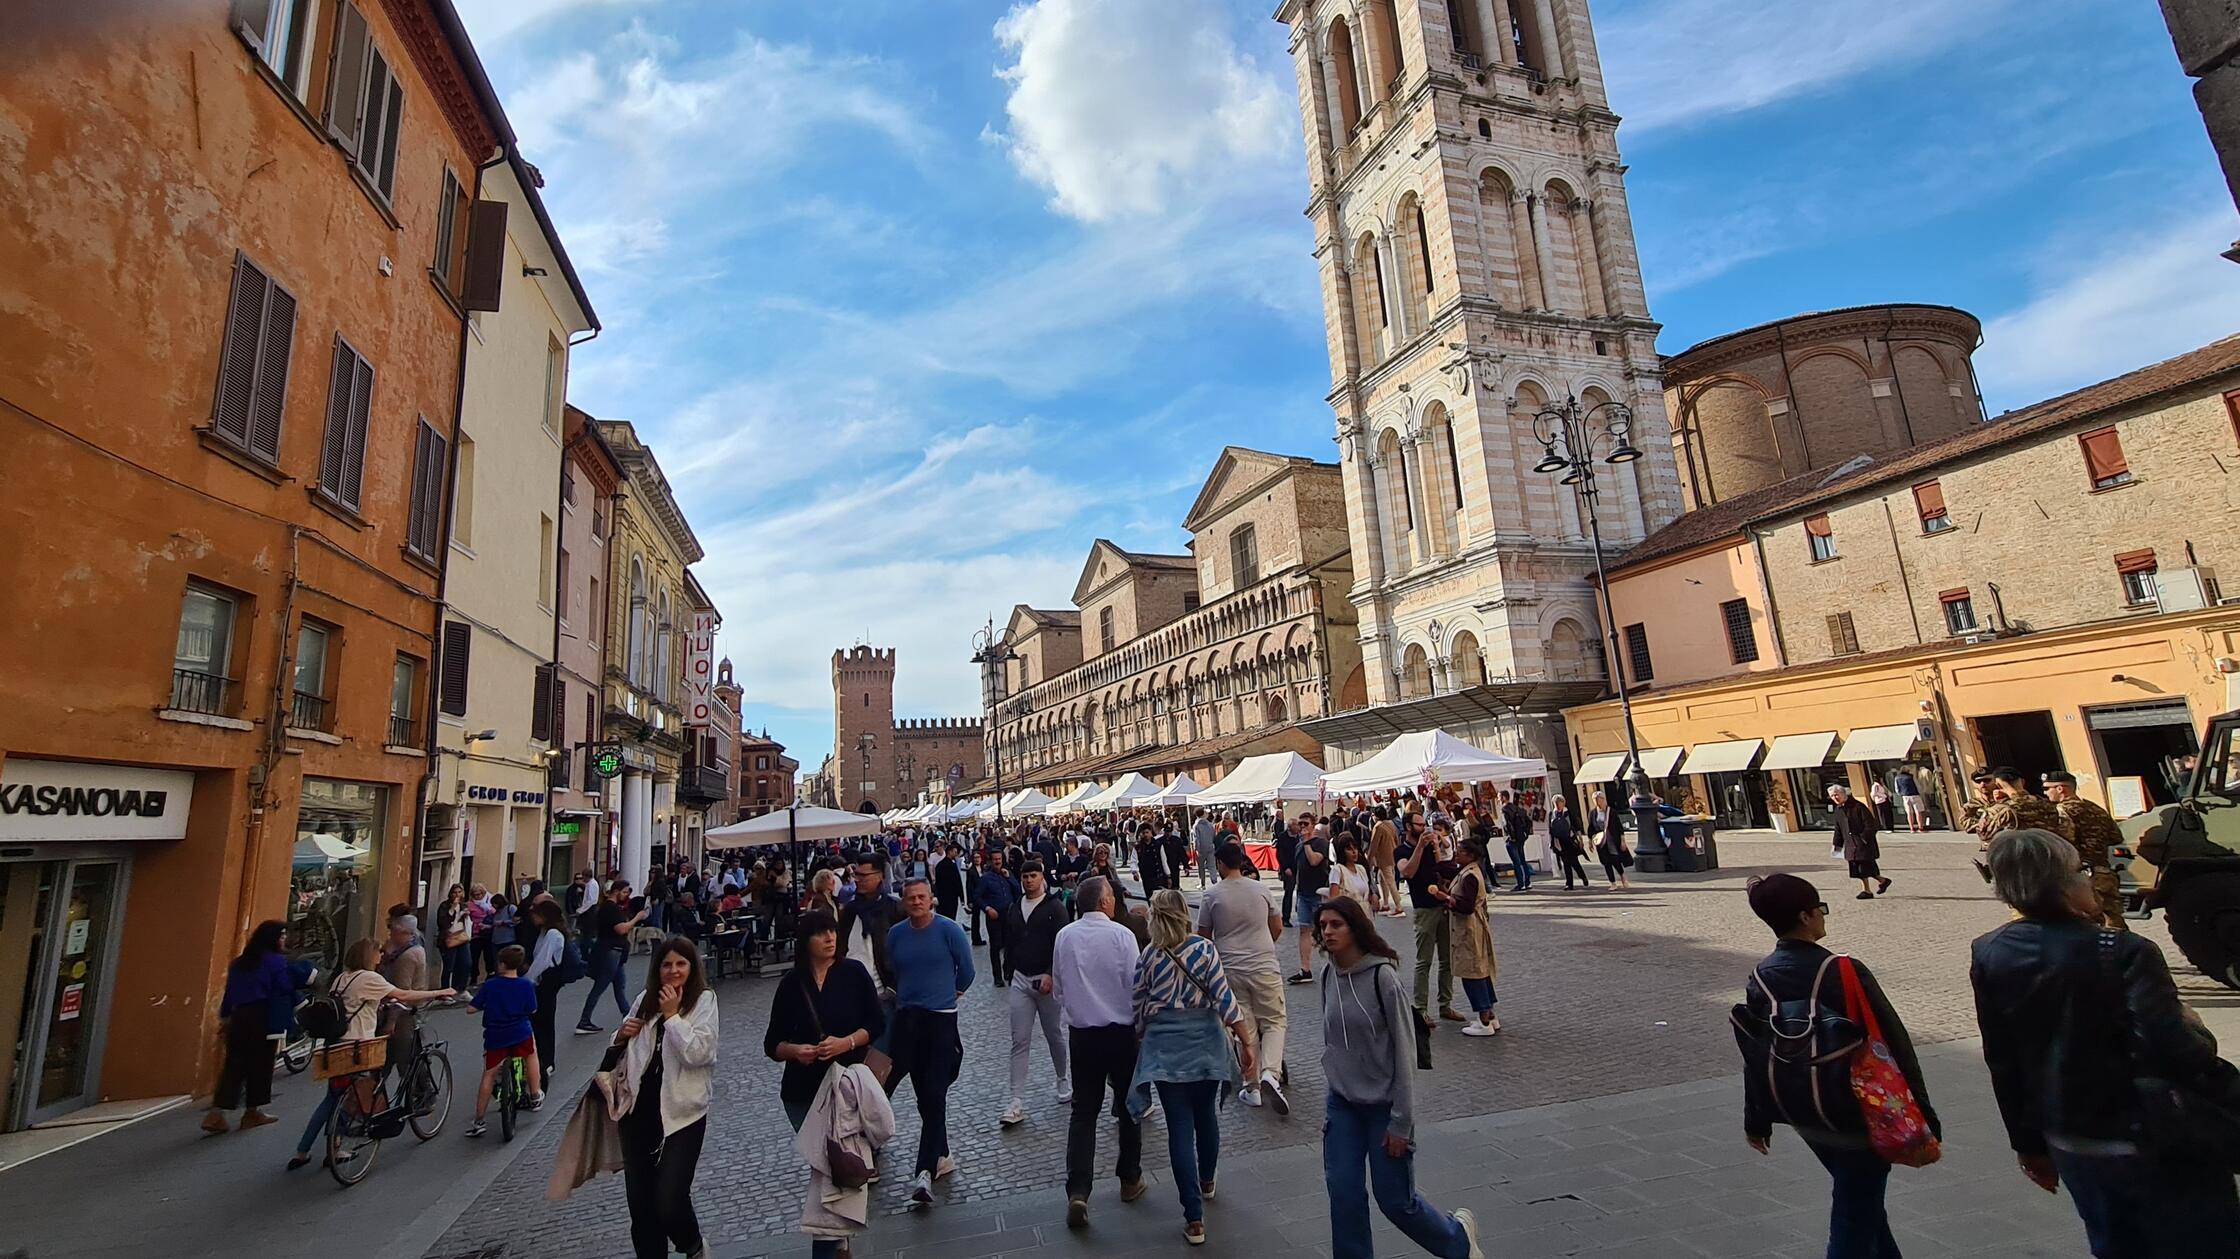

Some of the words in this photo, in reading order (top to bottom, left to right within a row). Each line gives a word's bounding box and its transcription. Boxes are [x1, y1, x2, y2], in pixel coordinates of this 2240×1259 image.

[694, 616, 711, 719] NUOVO
[0, 783, 142, 817] KASANOVA
[468, 785, 507, 801] GROM
[512, 791, 544, 804] GROM
